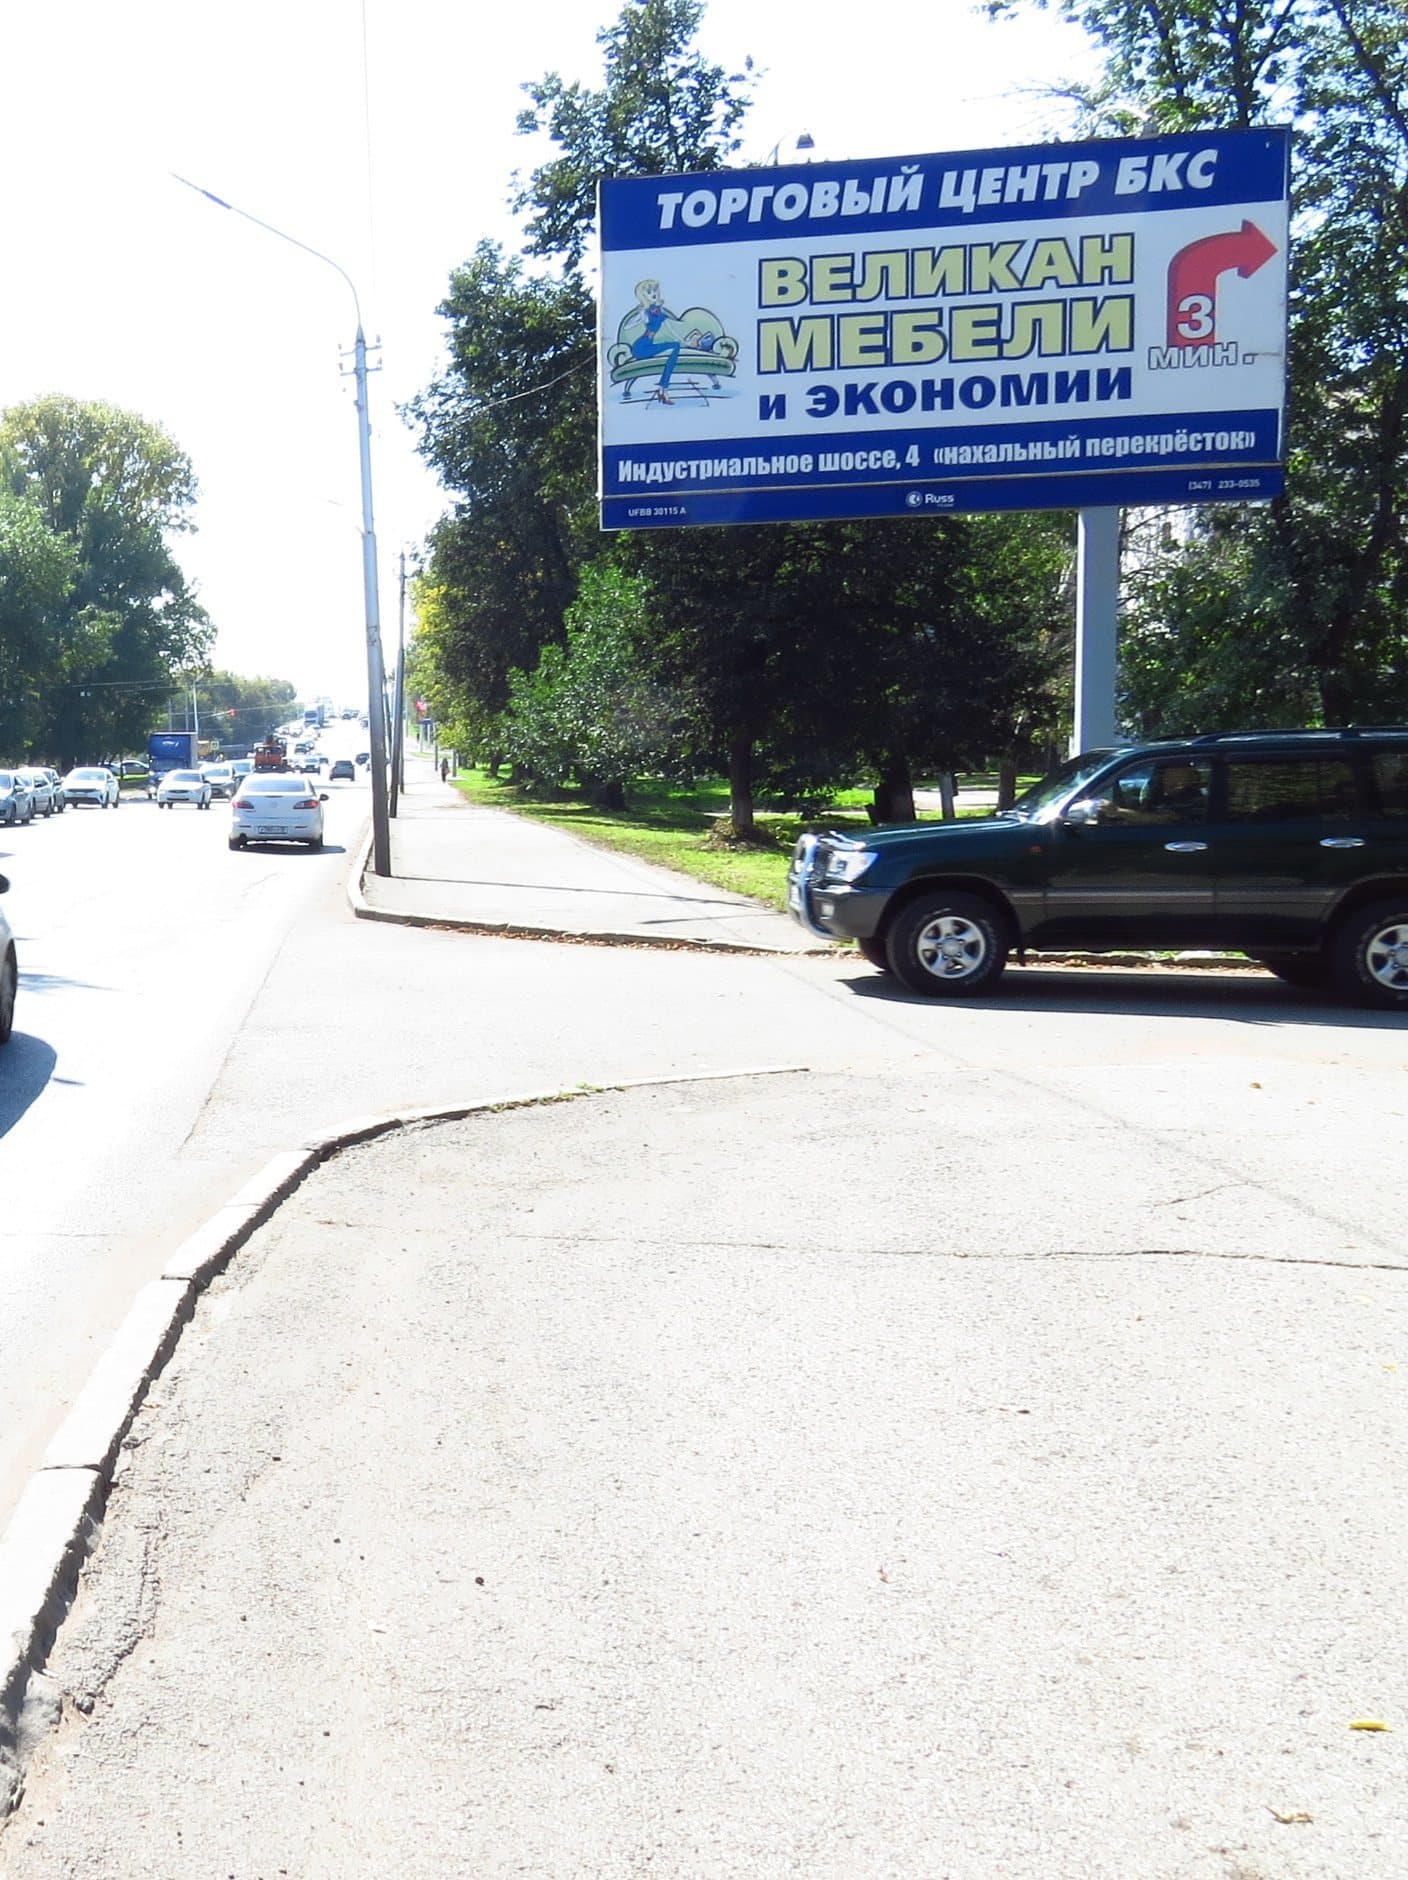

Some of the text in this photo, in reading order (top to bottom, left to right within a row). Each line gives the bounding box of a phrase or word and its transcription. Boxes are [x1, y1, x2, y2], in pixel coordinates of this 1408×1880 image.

[657, 149, 1220, 230] ТОРГОВЫЙ ЦЕНТР БКС
[757, 232, 1136, 310] ВЕЛИКАН
[756, 294, 1136, 375] МЕБЕЛИ
[1176, 293, 1216, 340] 3
[805, 366, 1133, 418] ЭКОНОМИИ
[617, 453, 813, 484] Индустриальное
[818, 448, 901, 473] шоссе,
[905, 444, 920, 468] 4
[933, 434, 1081, 466] «нахальный
[924, 493, 955, 504] Russ
